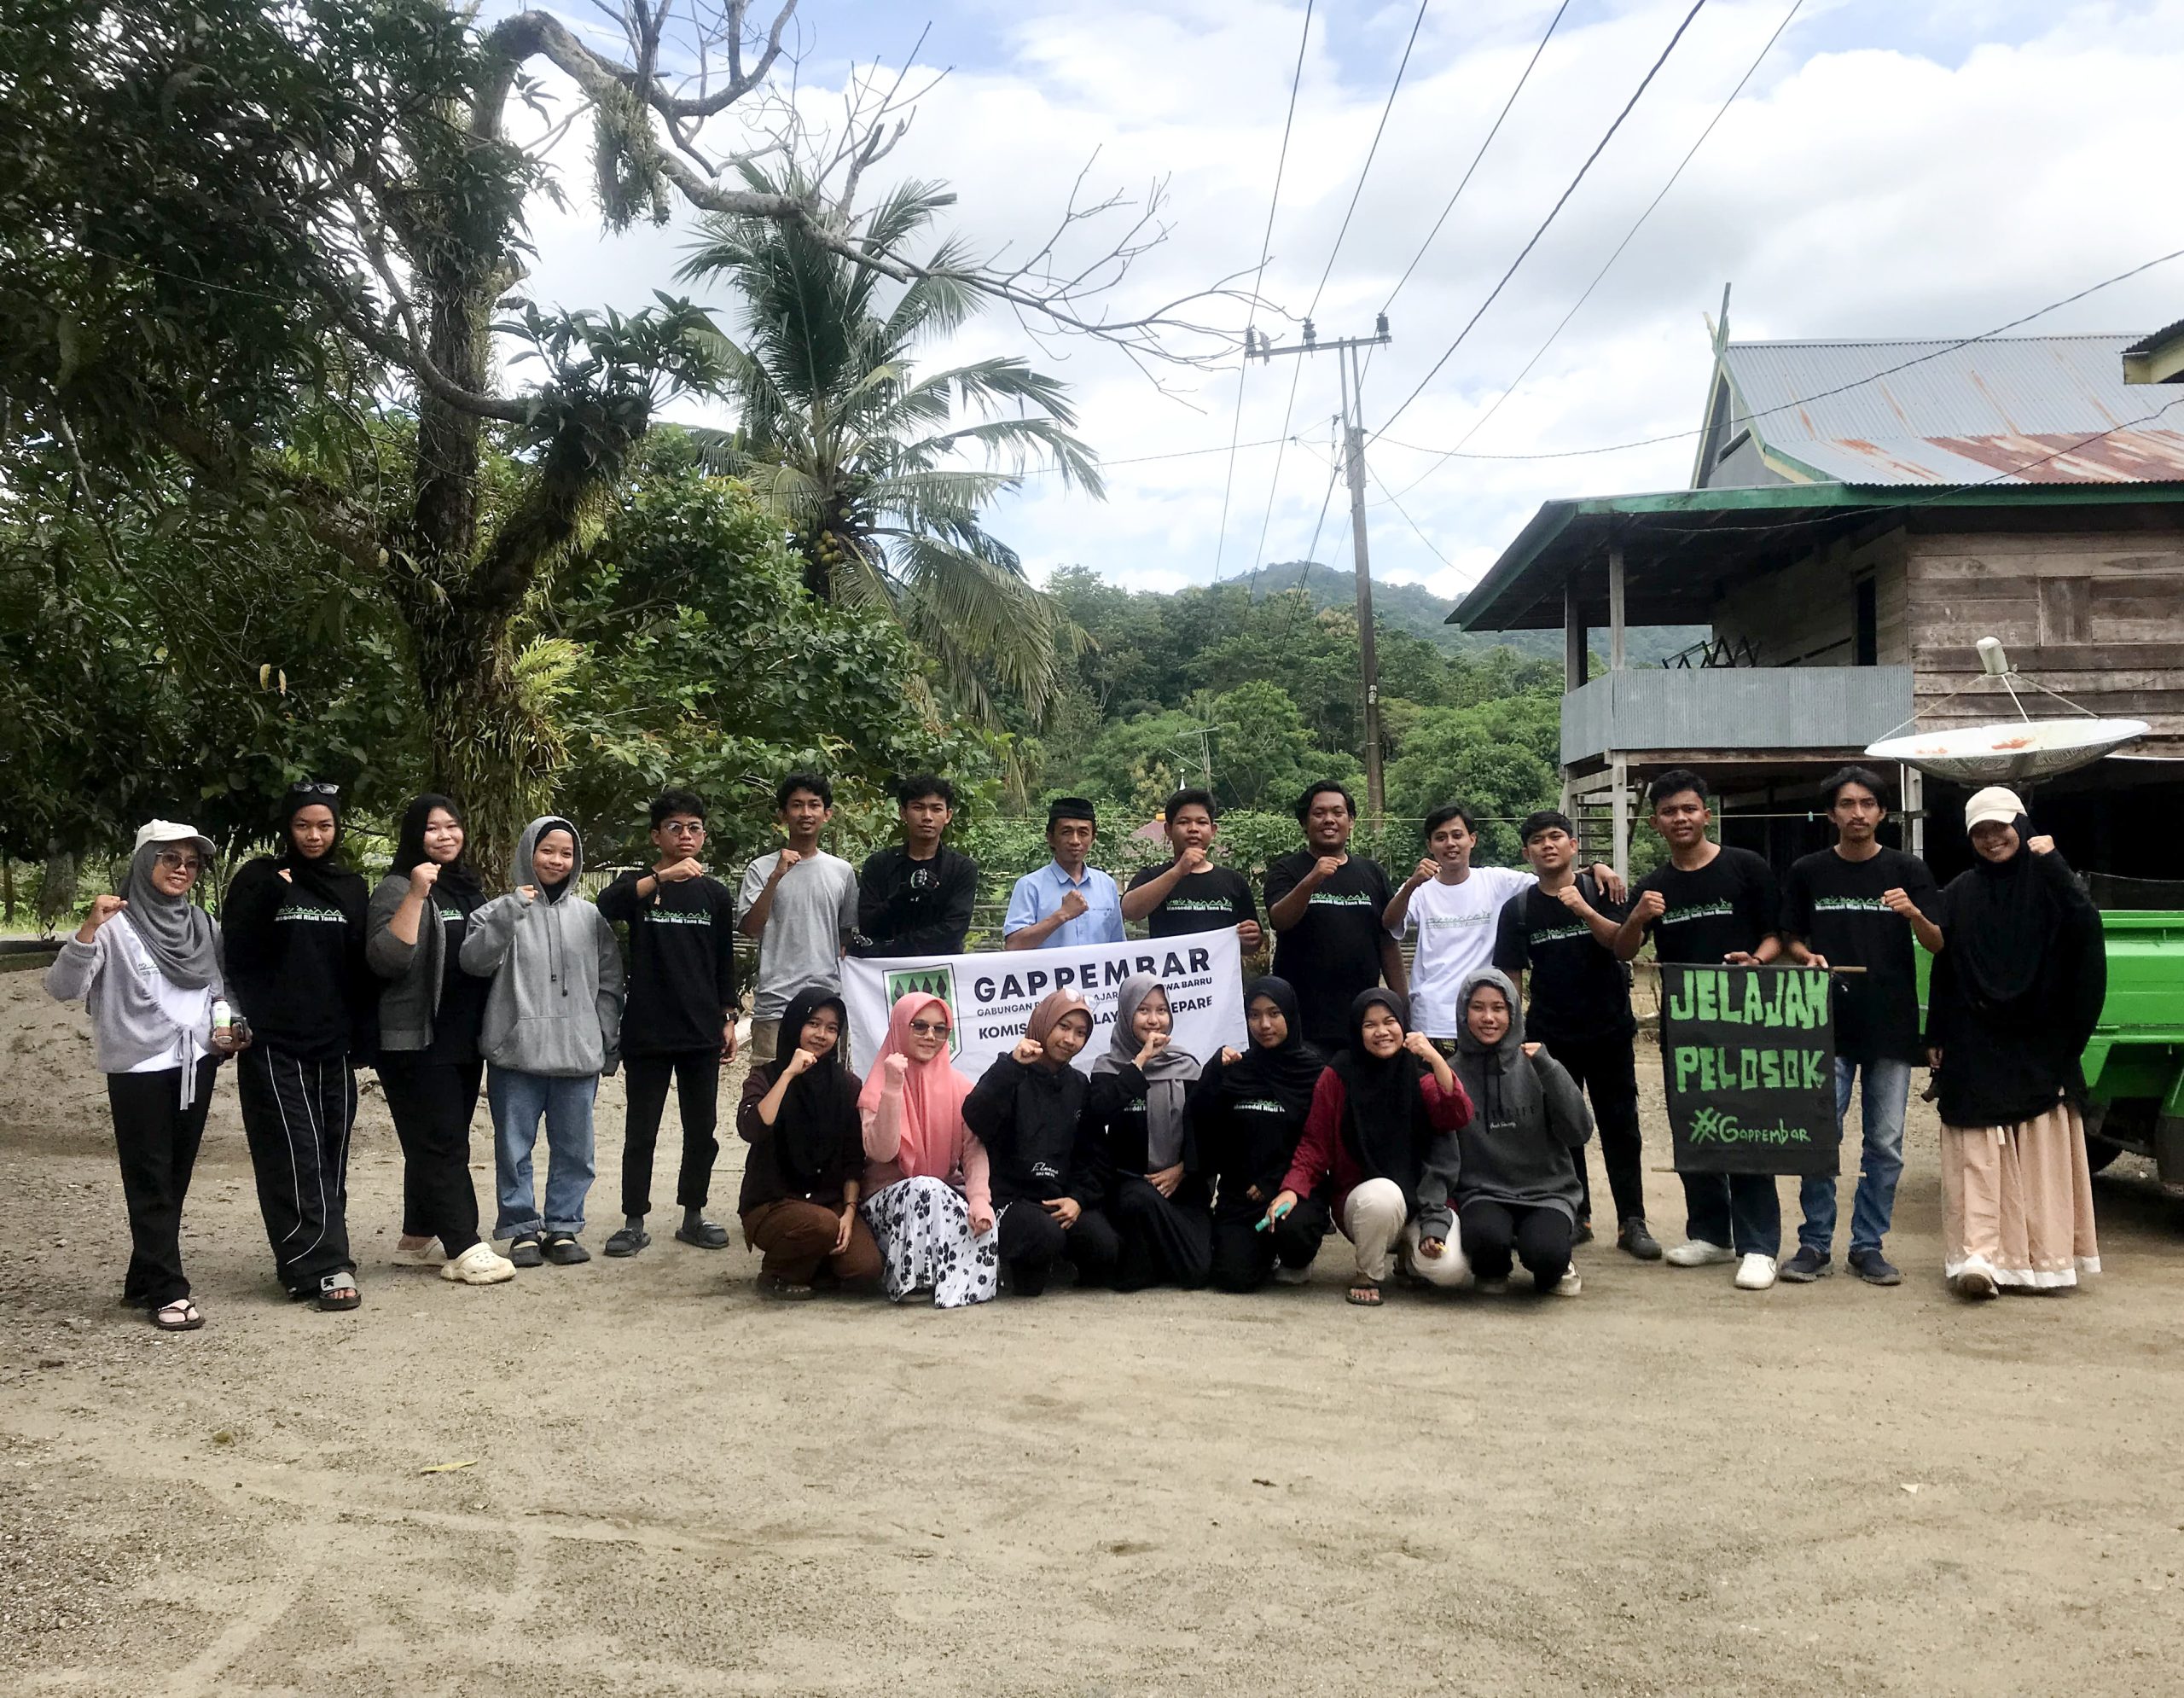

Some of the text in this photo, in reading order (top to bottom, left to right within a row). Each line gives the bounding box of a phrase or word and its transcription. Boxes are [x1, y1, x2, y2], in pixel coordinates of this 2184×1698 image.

[974, 947, 1211, 1003] GAPPEMBAR
[977, 1002, 1032, 1016] GABUNGAN
[1182, 977, 1212, 988] BARRU
[979, 1023, 1028, 1039] KOMIS
[1171, 996, 1212, 1014] EPARE
[1670, 969, 1829, 1029] JELAJAH
[1675, 1046, 1827, 1093] PELOSOK
